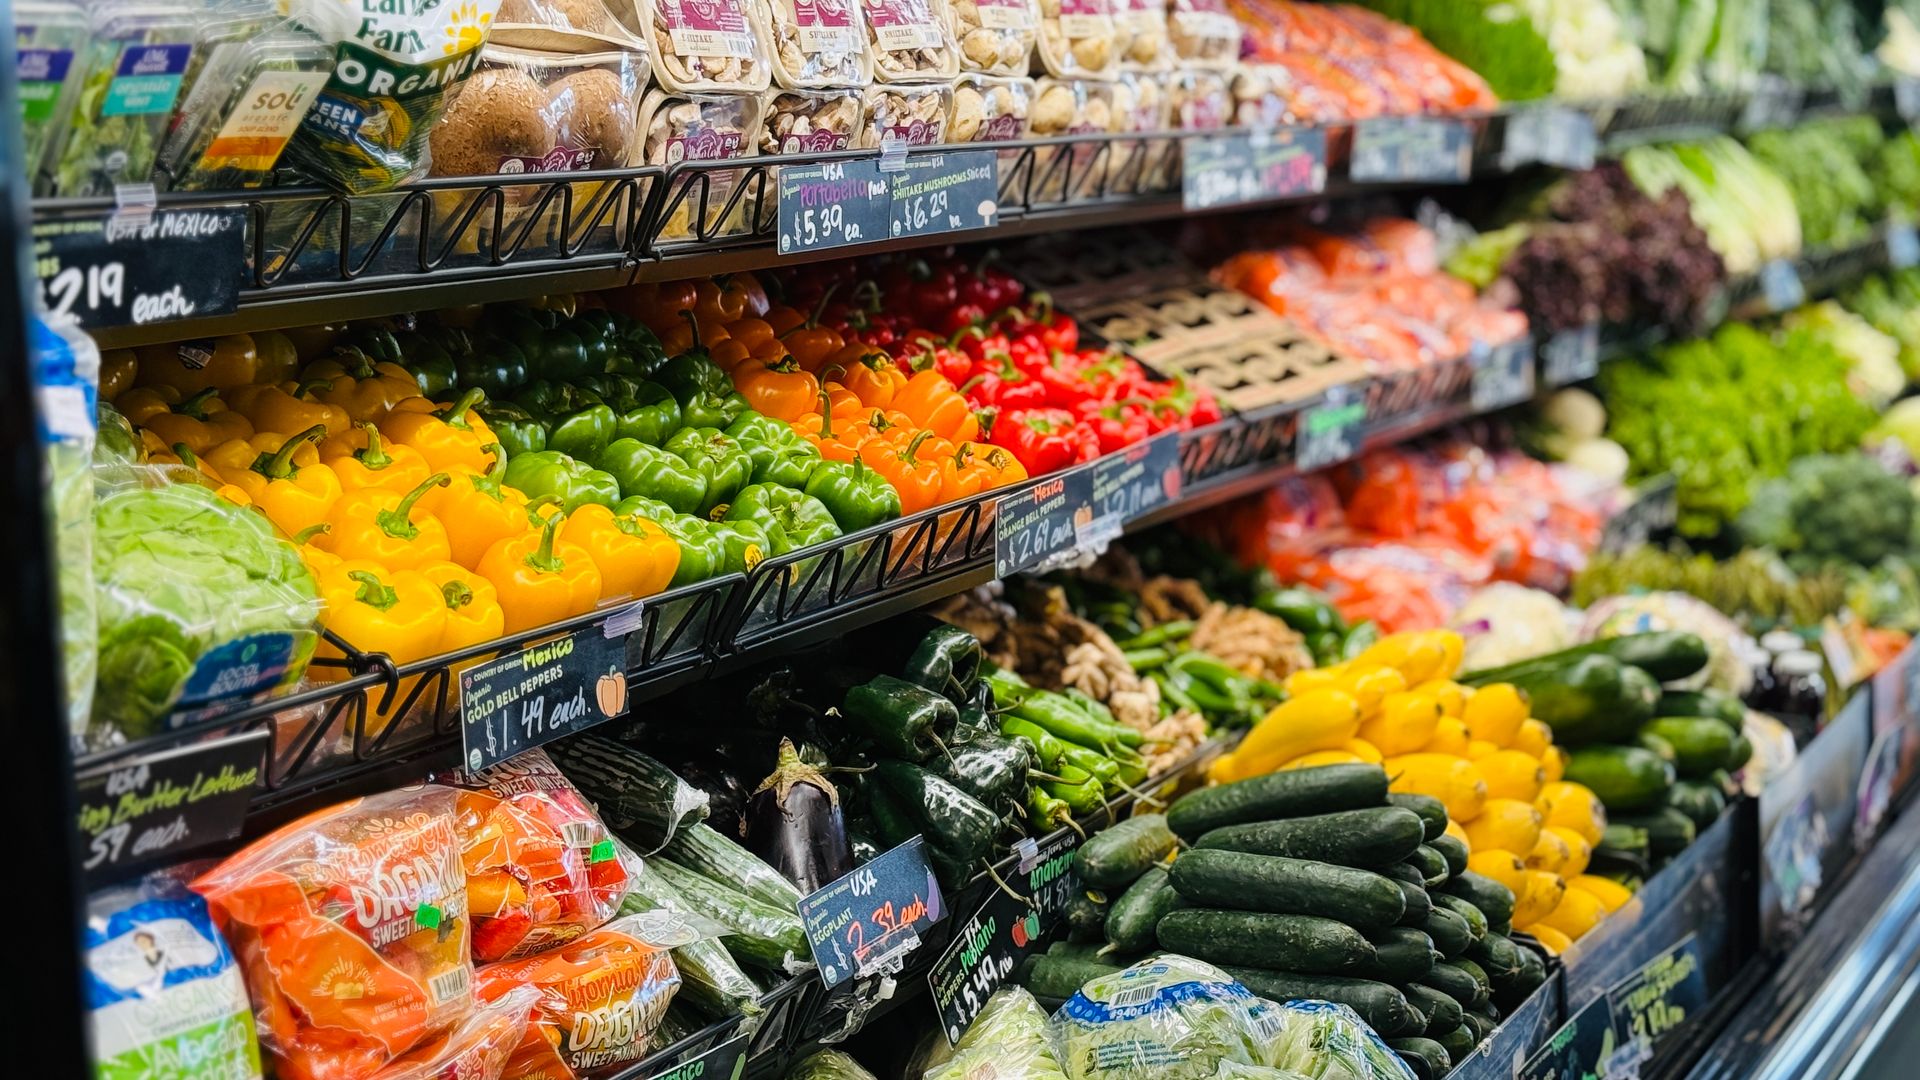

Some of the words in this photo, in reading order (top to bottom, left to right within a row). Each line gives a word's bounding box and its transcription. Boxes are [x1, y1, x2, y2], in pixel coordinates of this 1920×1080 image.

[309, 101, 357, 123] REEN
[823, 164, 845, 181] USA
[923, 171, 967, 193] MUSHROOMS
[932, 155, 945, 169] USA
[160, 212, 219, 239] MEXICO
[794, 204, 843, 246] $5.39
[904, 190, 948, 232] $6.29
[132, 284, 194, 324] each
[998, 520, 1025, 541] ORANGE
[1025, 509, 1040, 527] BELL
[1039, 494, 1066, 516] PEPPERS
[1008, 518, 1050, 567] $2.69
[473, 668, 497, 683] COUNTRY
[497, 665, 505, 674] OF
[504, 657, 523, 671] ORIGIN
[522, 638, 575, 672] Mexico
[465, 682, 492, 708] Organic
[467, 699, 495, 724] GOLD
[496, 686, 519, 709] BELL
[520, 664, 563, 696] PEPPERS
[489, 777, 533, 798] SWEET
[809, 895, 828, 909] COUNTRY
[850, 868, 878, 897] USA
[371, 917, 412, 949] SWEET
[812, 906, 853, 946] EGGPLANT
[941, 969, 965, 1011] PEPPERS
[954, 954, 999, 1026] $5.49
[571, 1047, 612, 1069] SWEET
